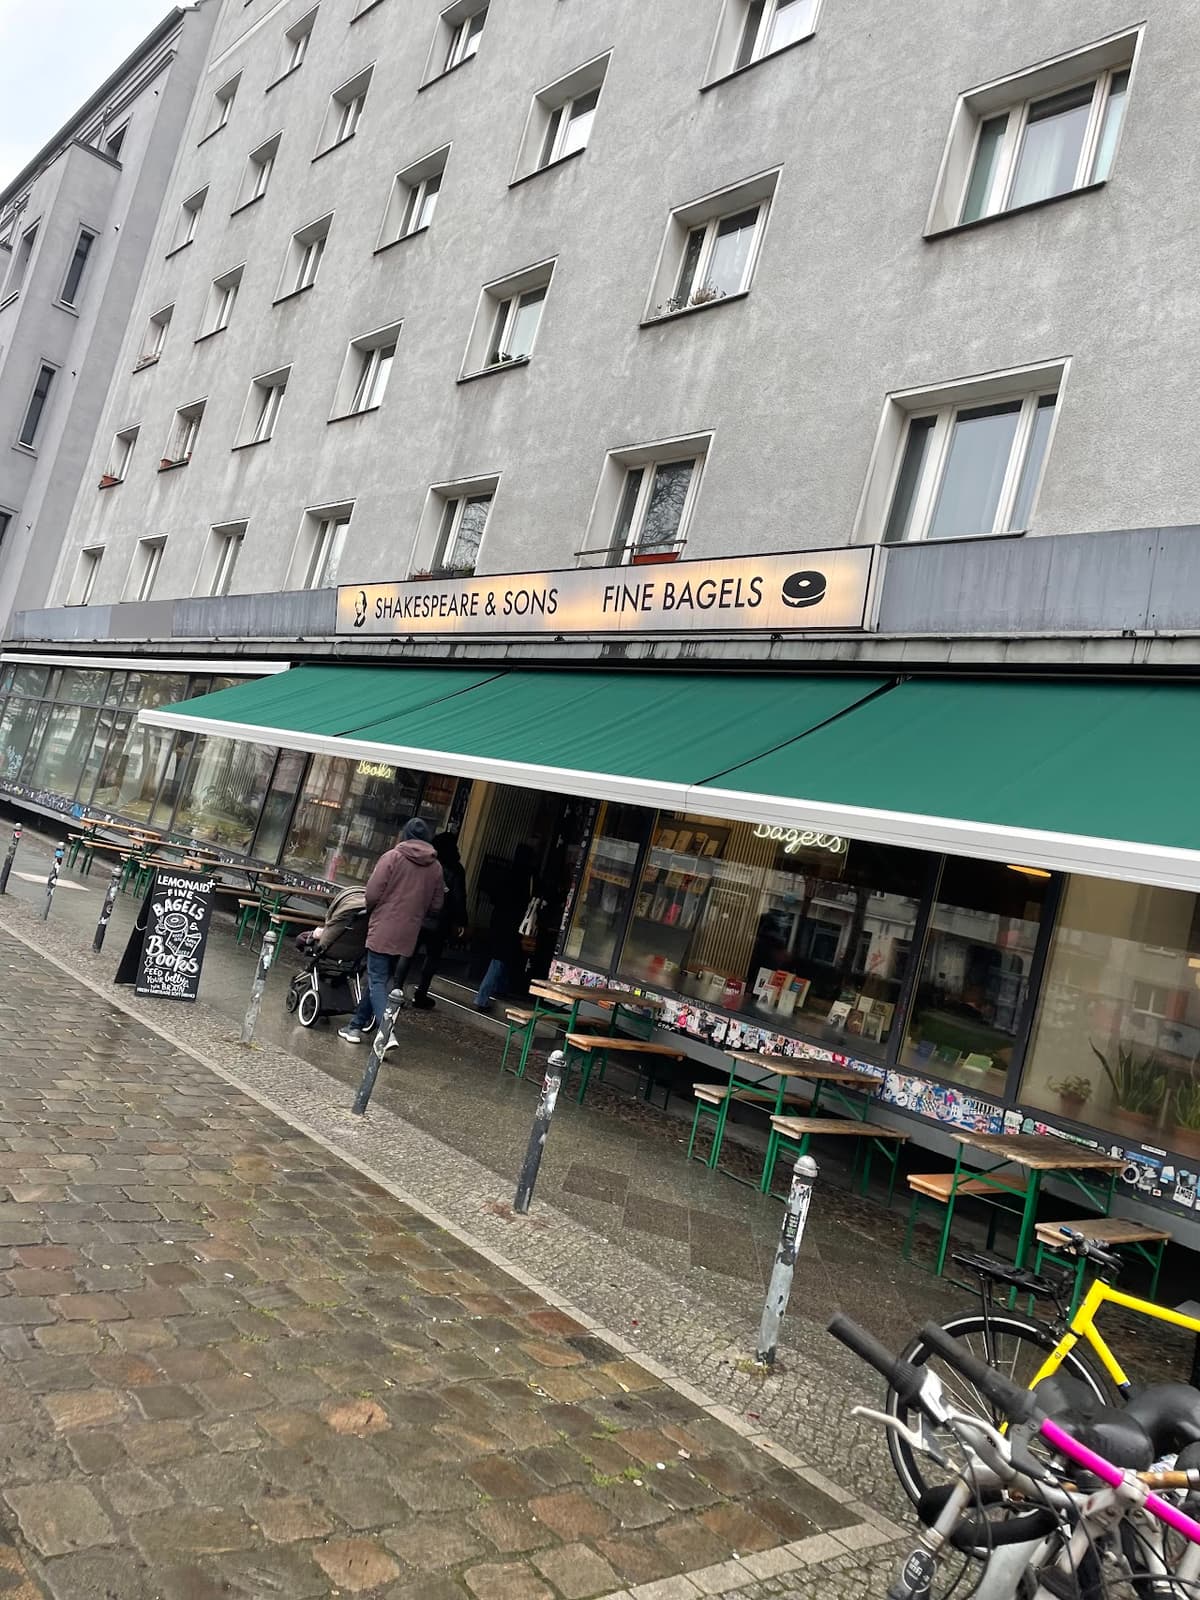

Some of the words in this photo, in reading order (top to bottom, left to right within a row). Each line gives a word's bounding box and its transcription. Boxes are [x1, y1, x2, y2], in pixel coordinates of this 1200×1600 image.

[375, 591, 480, 620] SHAKESPEARE
[484, 591, 497, 616] &
[503, 588, 559, 616] SONS
[602, 583, 655, 613] FINE
[662, 576, 764, 611] BAGELS
[167, 888, 194, 900] FINE
[152, 898, 205, 921] BAGELS
[143, 967, 163, 977] FEED
